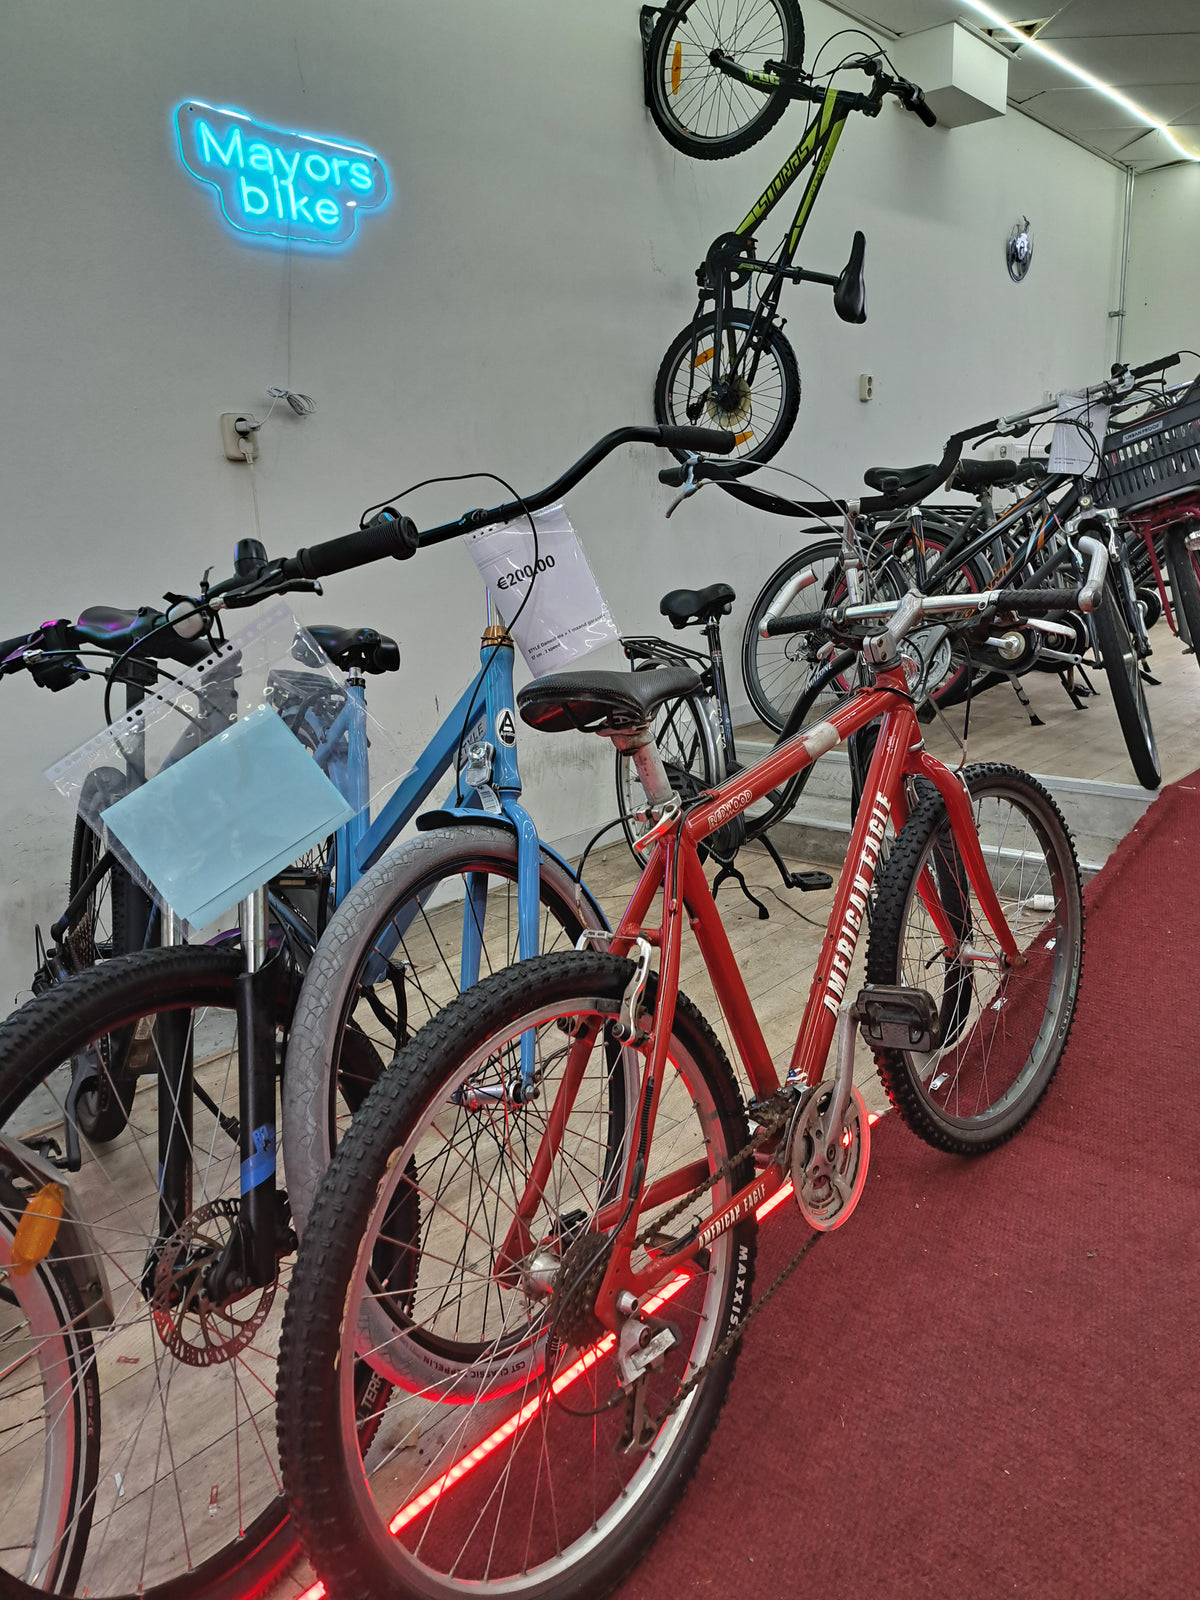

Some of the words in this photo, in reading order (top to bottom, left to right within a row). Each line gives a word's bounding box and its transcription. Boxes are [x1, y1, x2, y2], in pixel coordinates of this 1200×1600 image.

[198, 119, 373, 190] Mayors
[240, 174, 340, 225] bike
[496, 554, 556, 590] €200.00
[708, 789, 752, 829] REDWOOD
[824, 875, 871, 1018] AMERICAN
[861, 791, 892, 871] EAGLE
